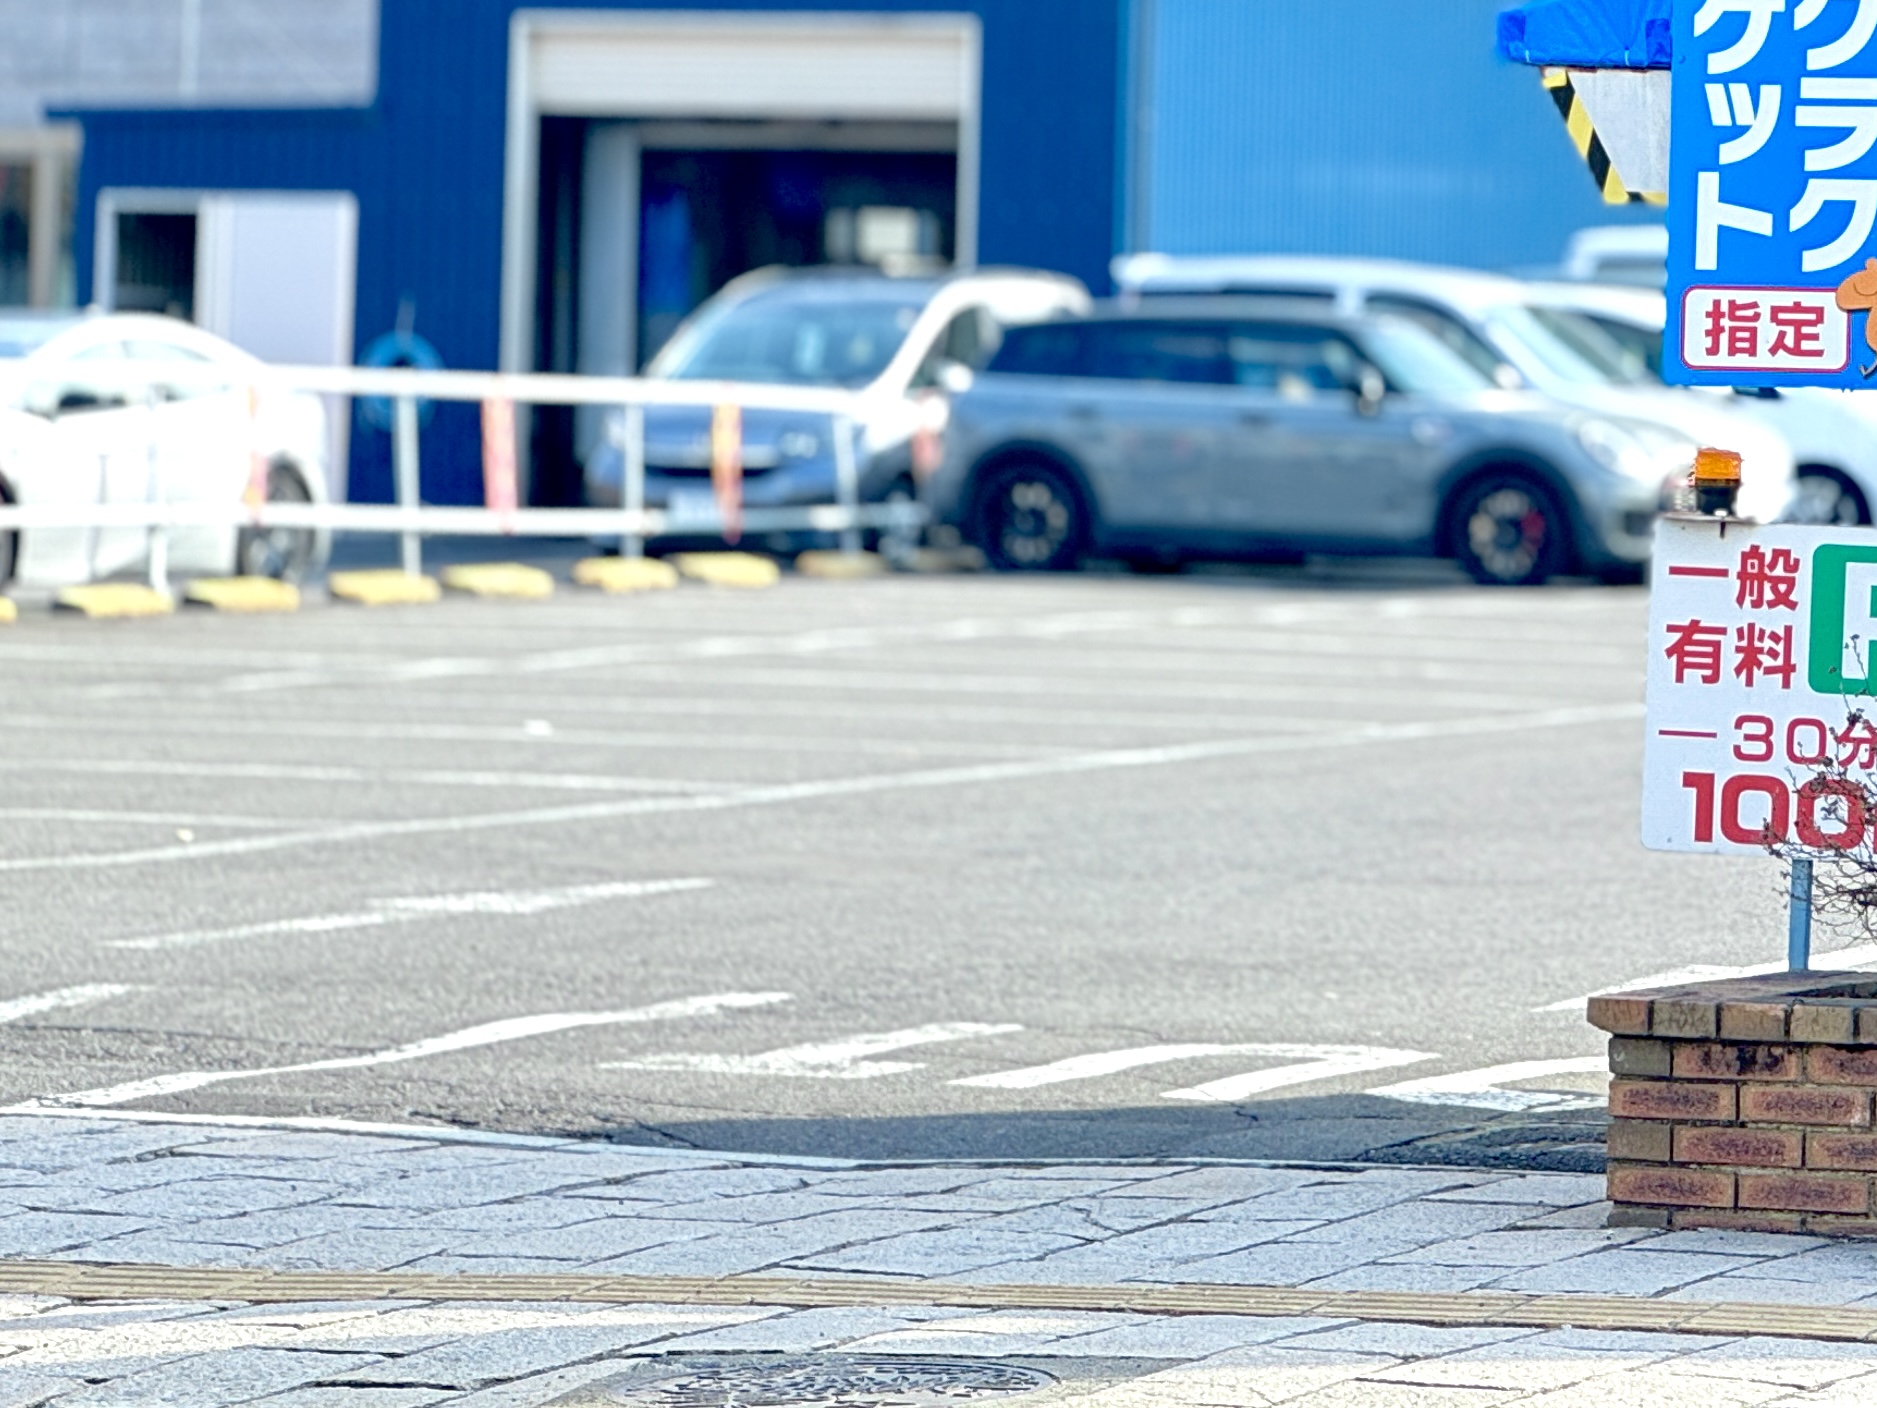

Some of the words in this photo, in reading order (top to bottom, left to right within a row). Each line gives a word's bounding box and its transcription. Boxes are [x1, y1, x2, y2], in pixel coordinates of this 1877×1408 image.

[1705, 300, 1826, 358] 指定
[1668, 544, 1801, 612] 一般
[1665, 619, 1797, 690] 有料
